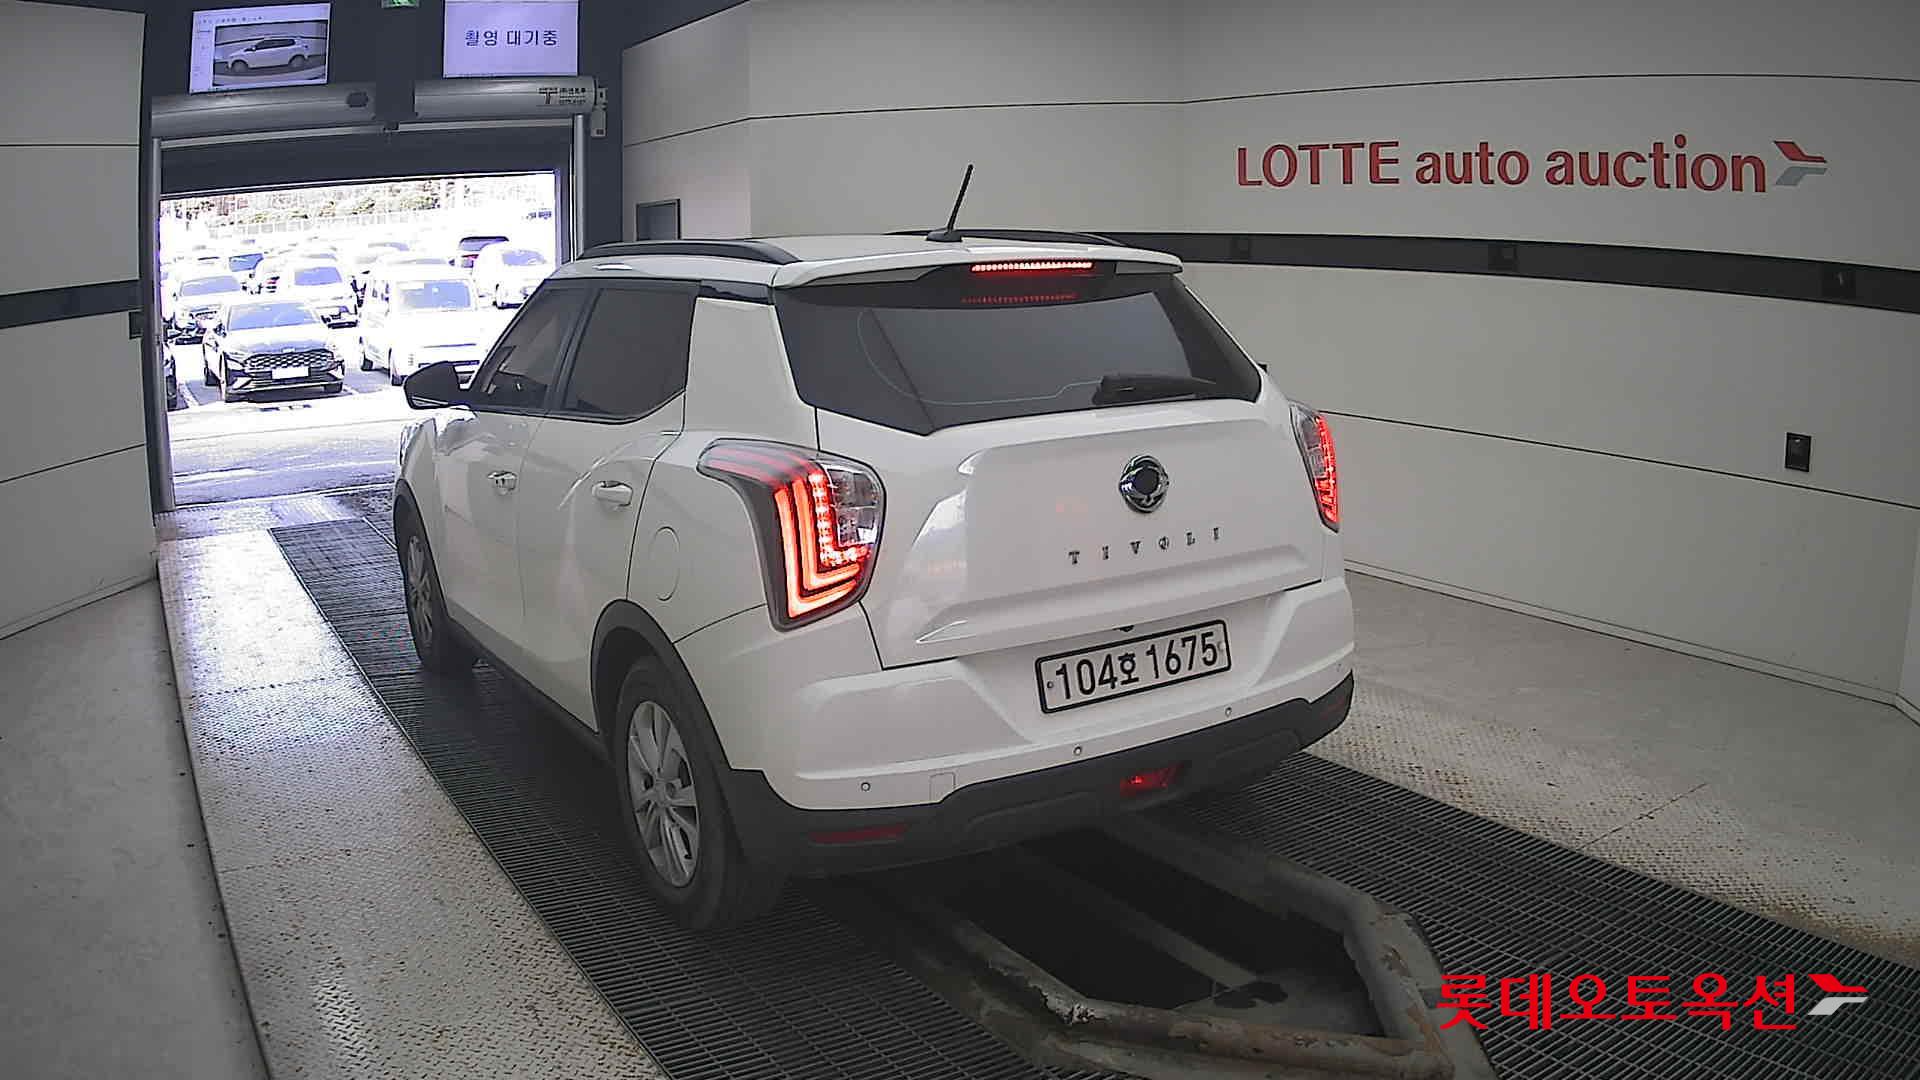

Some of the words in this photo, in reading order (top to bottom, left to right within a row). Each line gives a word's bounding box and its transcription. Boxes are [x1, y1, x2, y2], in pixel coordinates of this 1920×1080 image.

[465, 30, 498, 47] 촬영
[506, 29, 557, 46] 대기중
[1236, 141, 1400, 187] LOTTE
[1415, 141, 1529, 186] auto
[1544, 134, 1766, 193] auction
[1067, 527, 1221, 565] TIVOLI
